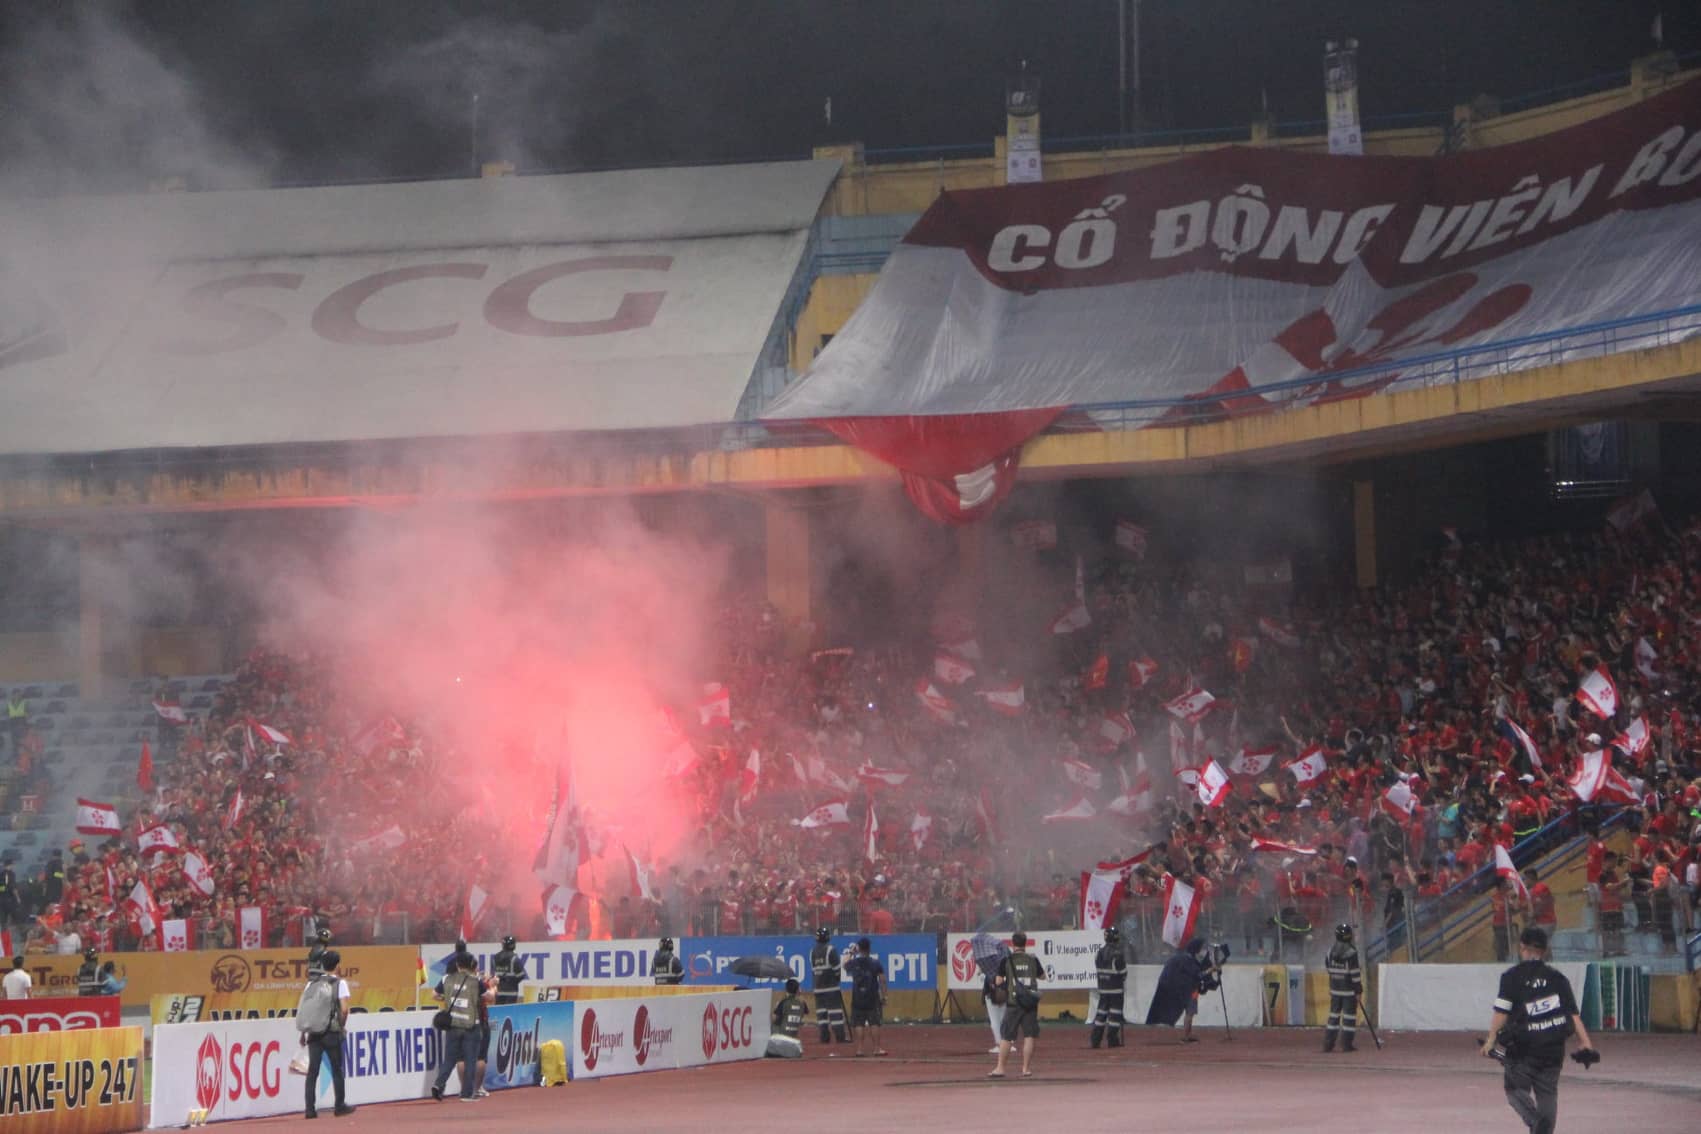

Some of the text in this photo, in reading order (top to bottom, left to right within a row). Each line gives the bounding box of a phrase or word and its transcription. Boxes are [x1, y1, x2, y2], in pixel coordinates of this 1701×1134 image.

[987, 194, 1127, 273] CỔ
[1399, 164, 1605, 264] VIÊN
[150, 255, 674, 357] SCG
[560, 950, 655, 980] MEDI
[888, 953, 928, 982] PTI
[721, 1006, 752, 1050] SCG
[98, 1056, 138, 1107] 247
[228, 1040, 281, 1102] SCG
